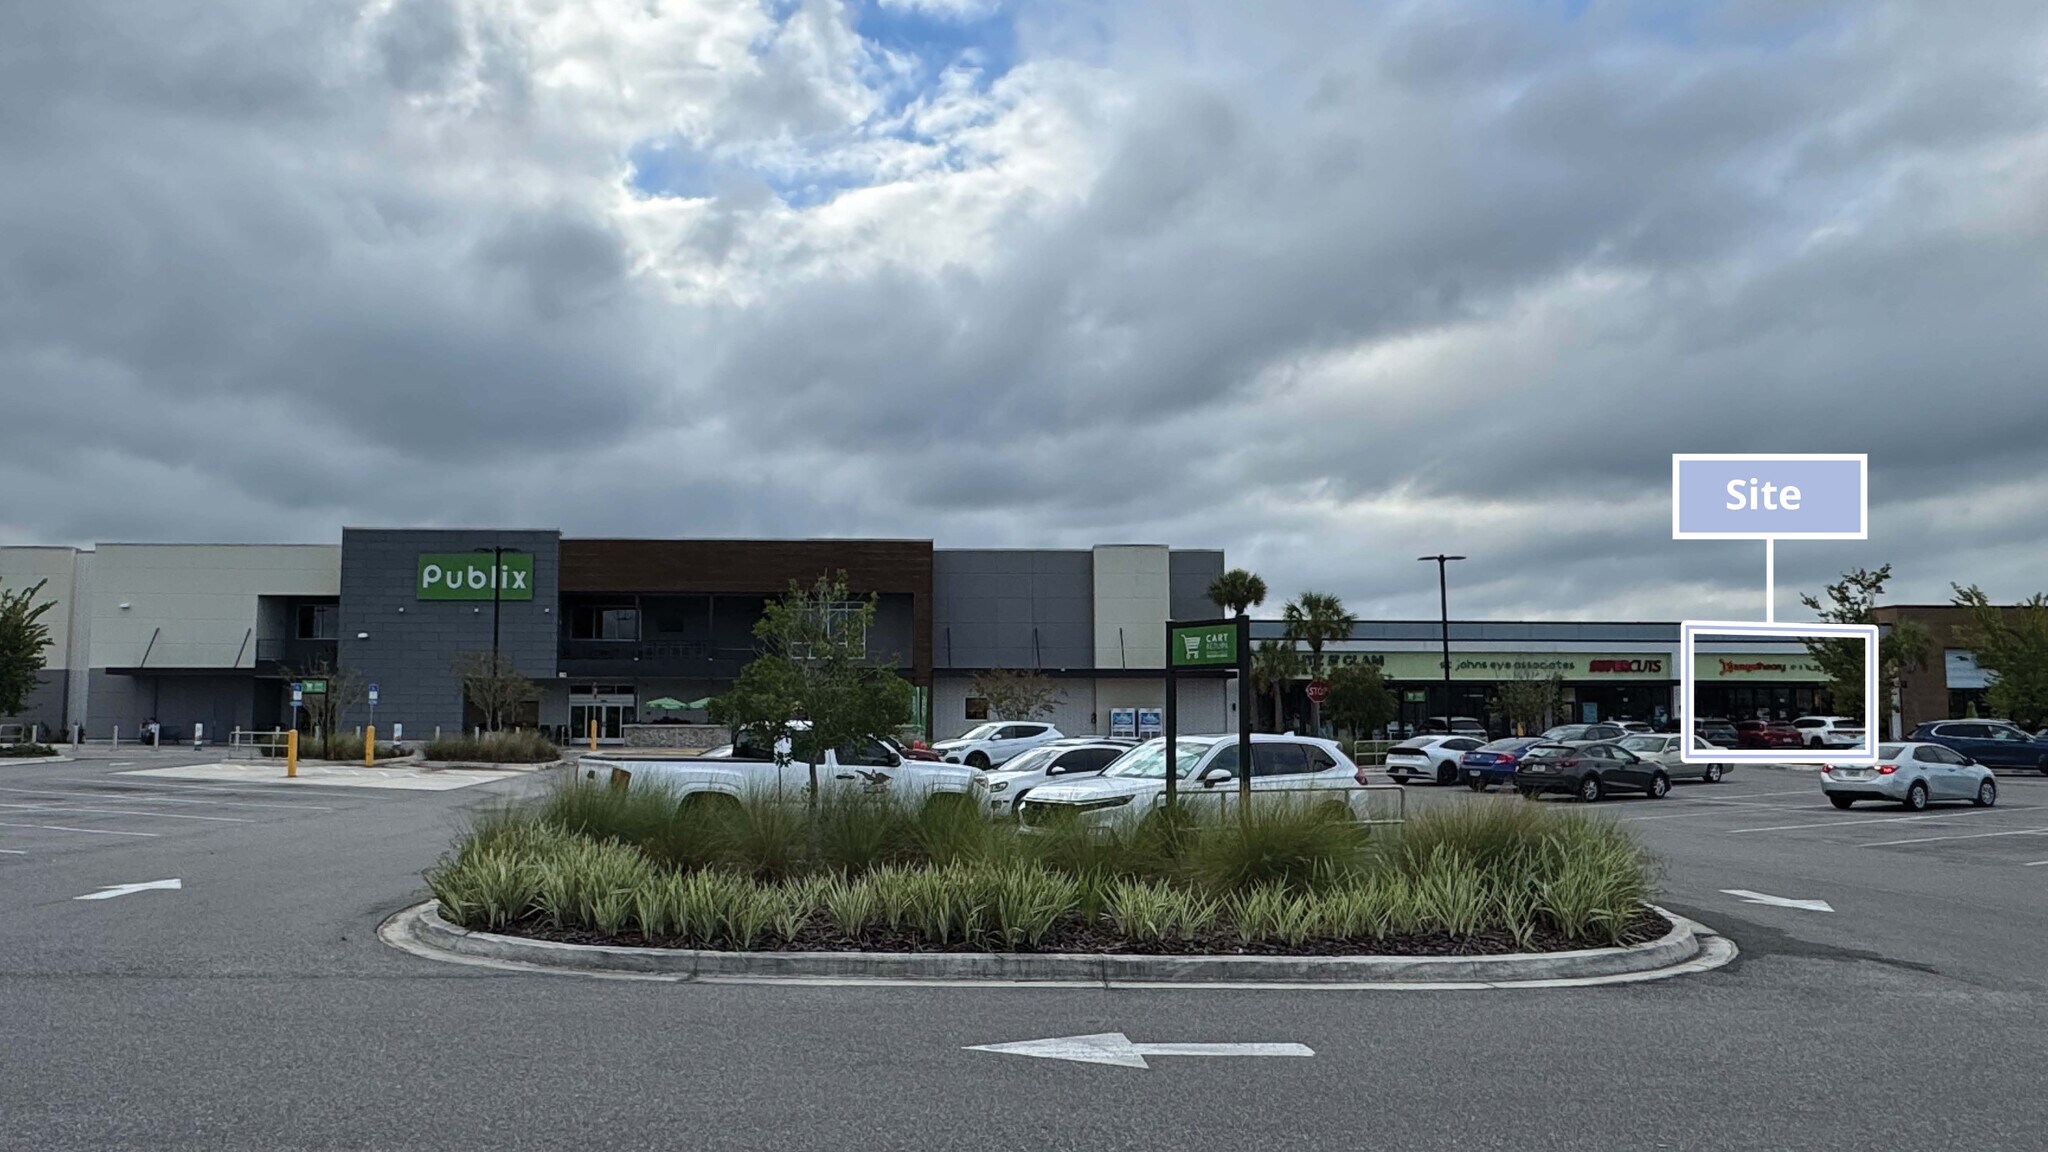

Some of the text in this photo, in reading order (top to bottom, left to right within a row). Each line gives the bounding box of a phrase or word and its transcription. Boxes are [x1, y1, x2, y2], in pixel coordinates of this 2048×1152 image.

[422, 564, 527, 589] Publix
[1205, 633, 1229, 643] CART
[1454, 660, 1488, 672] johns
[1490, 661, 1512, 672] eye
